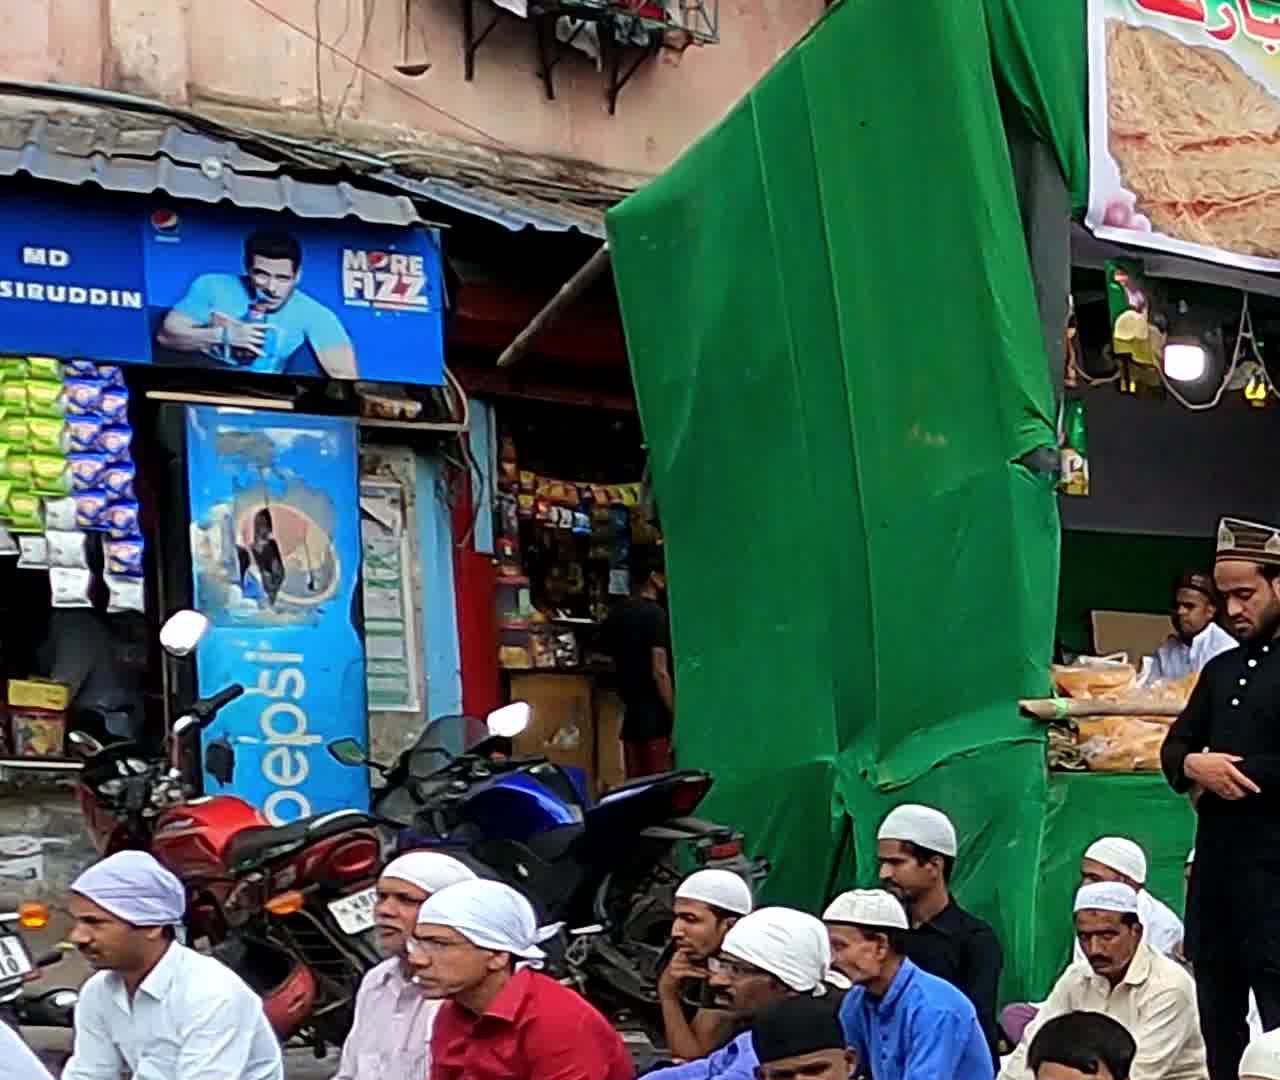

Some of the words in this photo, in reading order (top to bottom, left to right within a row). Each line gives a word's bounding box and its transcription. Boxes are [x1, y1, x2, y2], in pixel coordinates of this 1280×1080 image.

[23, 246, 70, 268] MD
[0, 280, 143, 309] SIRUDDIN
[342, 270, 429, 305] FIZZ
